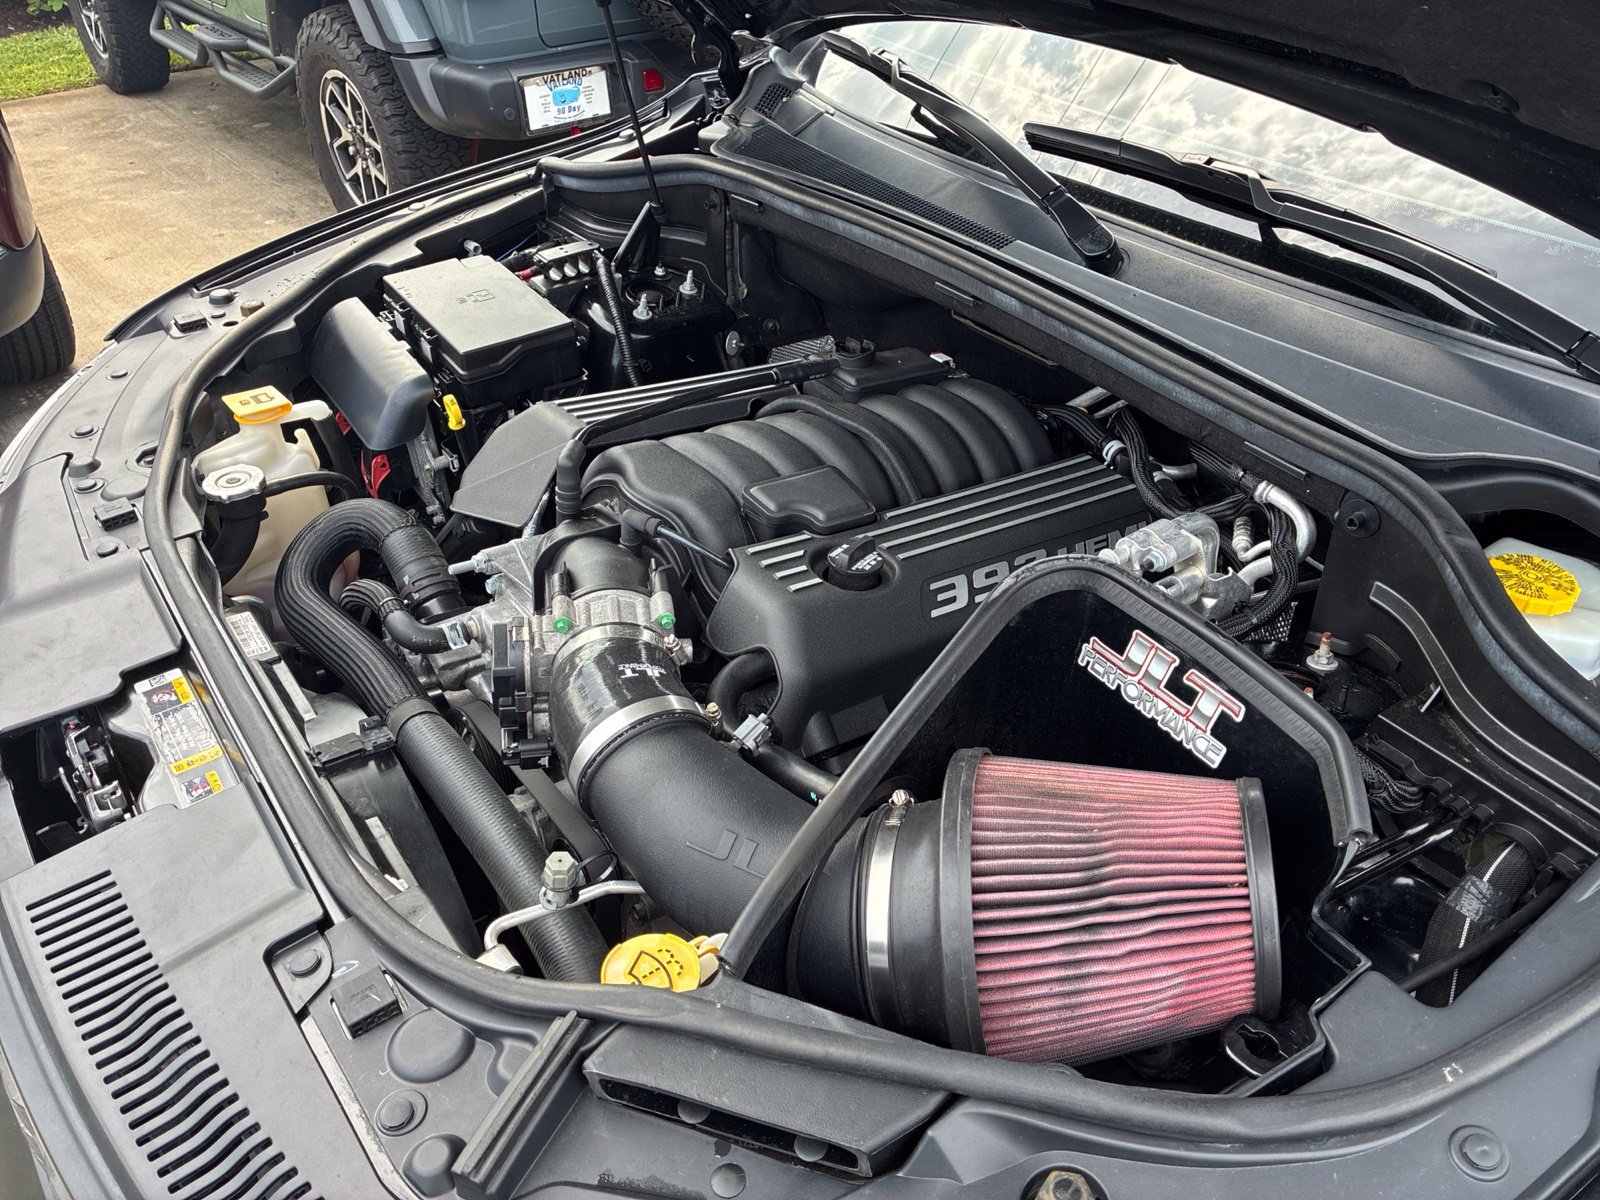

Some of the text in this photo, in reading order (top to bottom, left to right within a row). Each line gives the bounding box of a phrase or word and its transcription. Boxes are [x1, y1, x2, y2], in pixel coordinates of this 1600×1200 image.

[542, 68, 588, 85] VATLAND
[546, 77, 583, 92] VATLAND
[567, 104, 581, 113] Day
[1091, 630, 1244, 733] JLT
[1078, 644, 1226, 768] PERFORMANCE
[686, 829, 767, 879] JL
